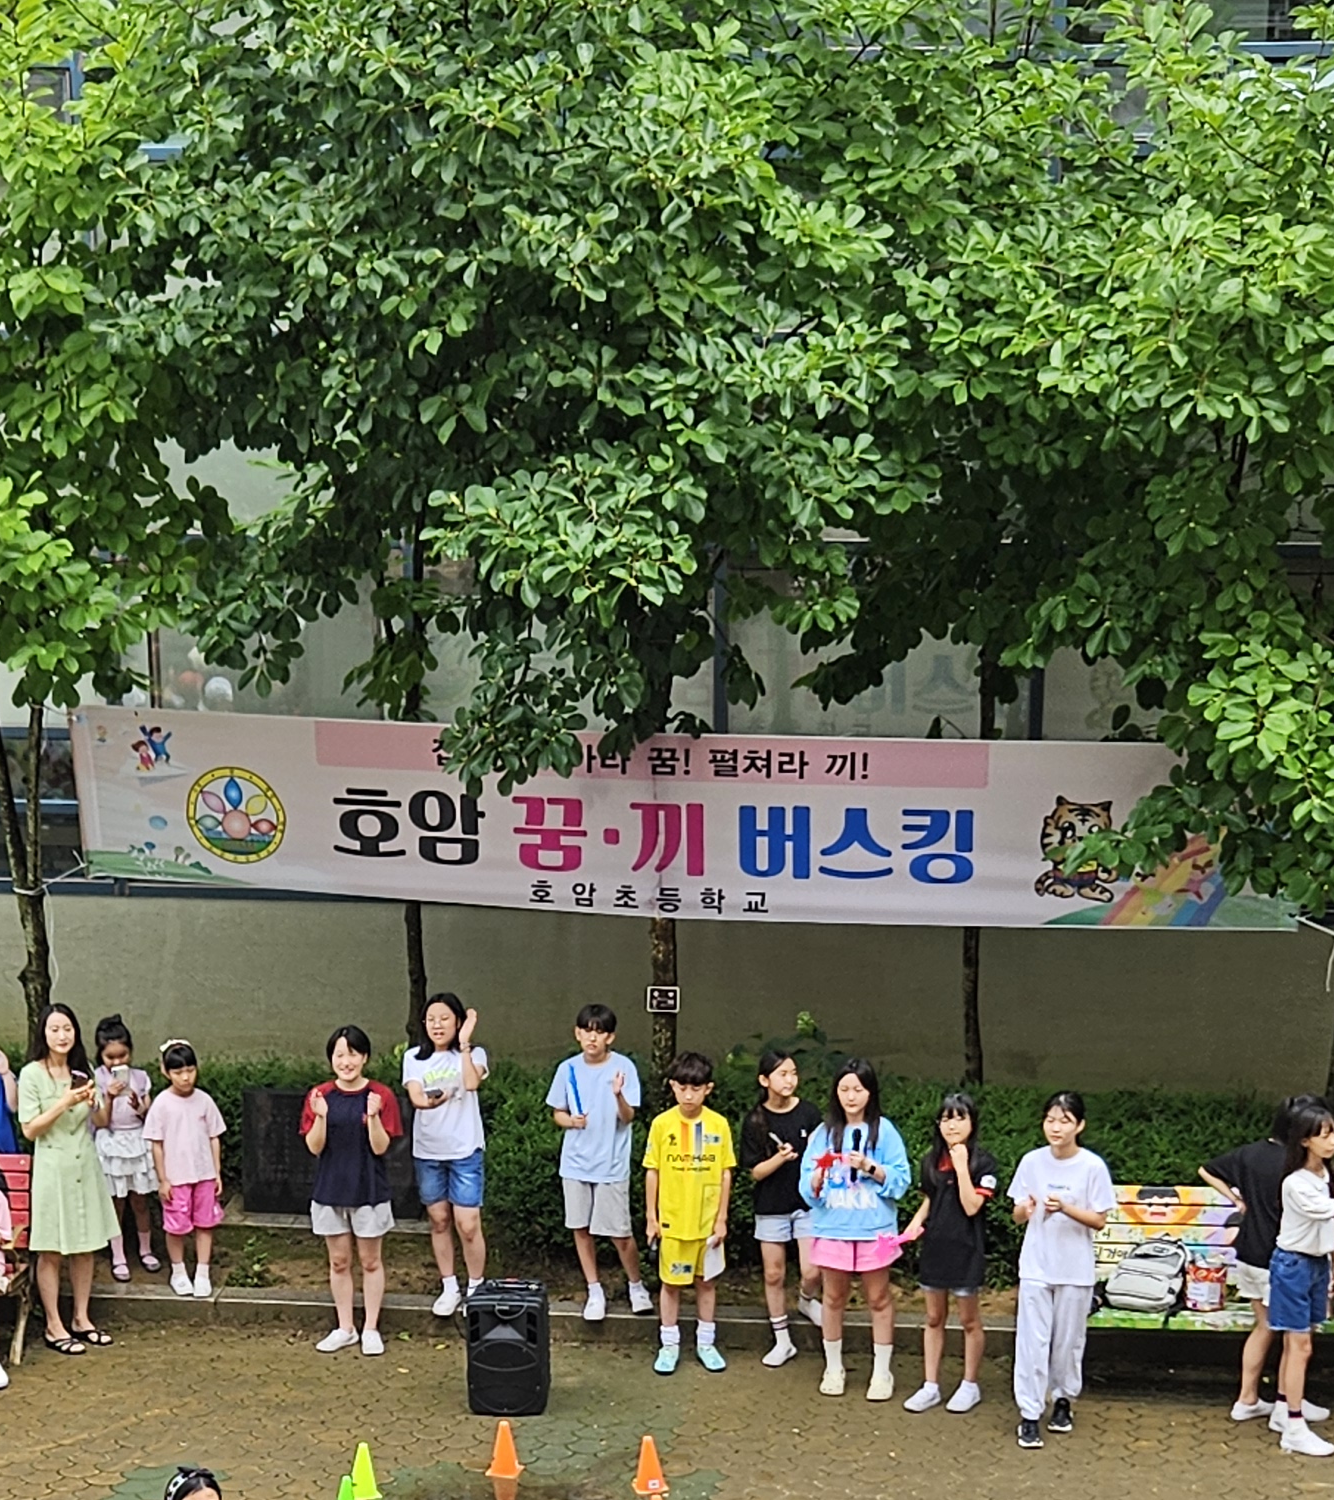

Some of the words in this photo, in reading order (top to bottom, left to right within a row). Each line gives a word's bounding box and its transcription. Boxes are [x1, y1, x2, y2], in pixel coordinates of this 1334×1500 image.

[647, 747, 691, 777] 꿈!
[709, 748, 809, 781] 펼쳐라
[824, 752, 870, 782] 끼!
[332, 785, 486, 866] 호암
[512, 795, 706, 877] 꿈·끼
[738, 804, 975, 884] 버스킹
[529, 878, 770, 915] 호암초등학교
